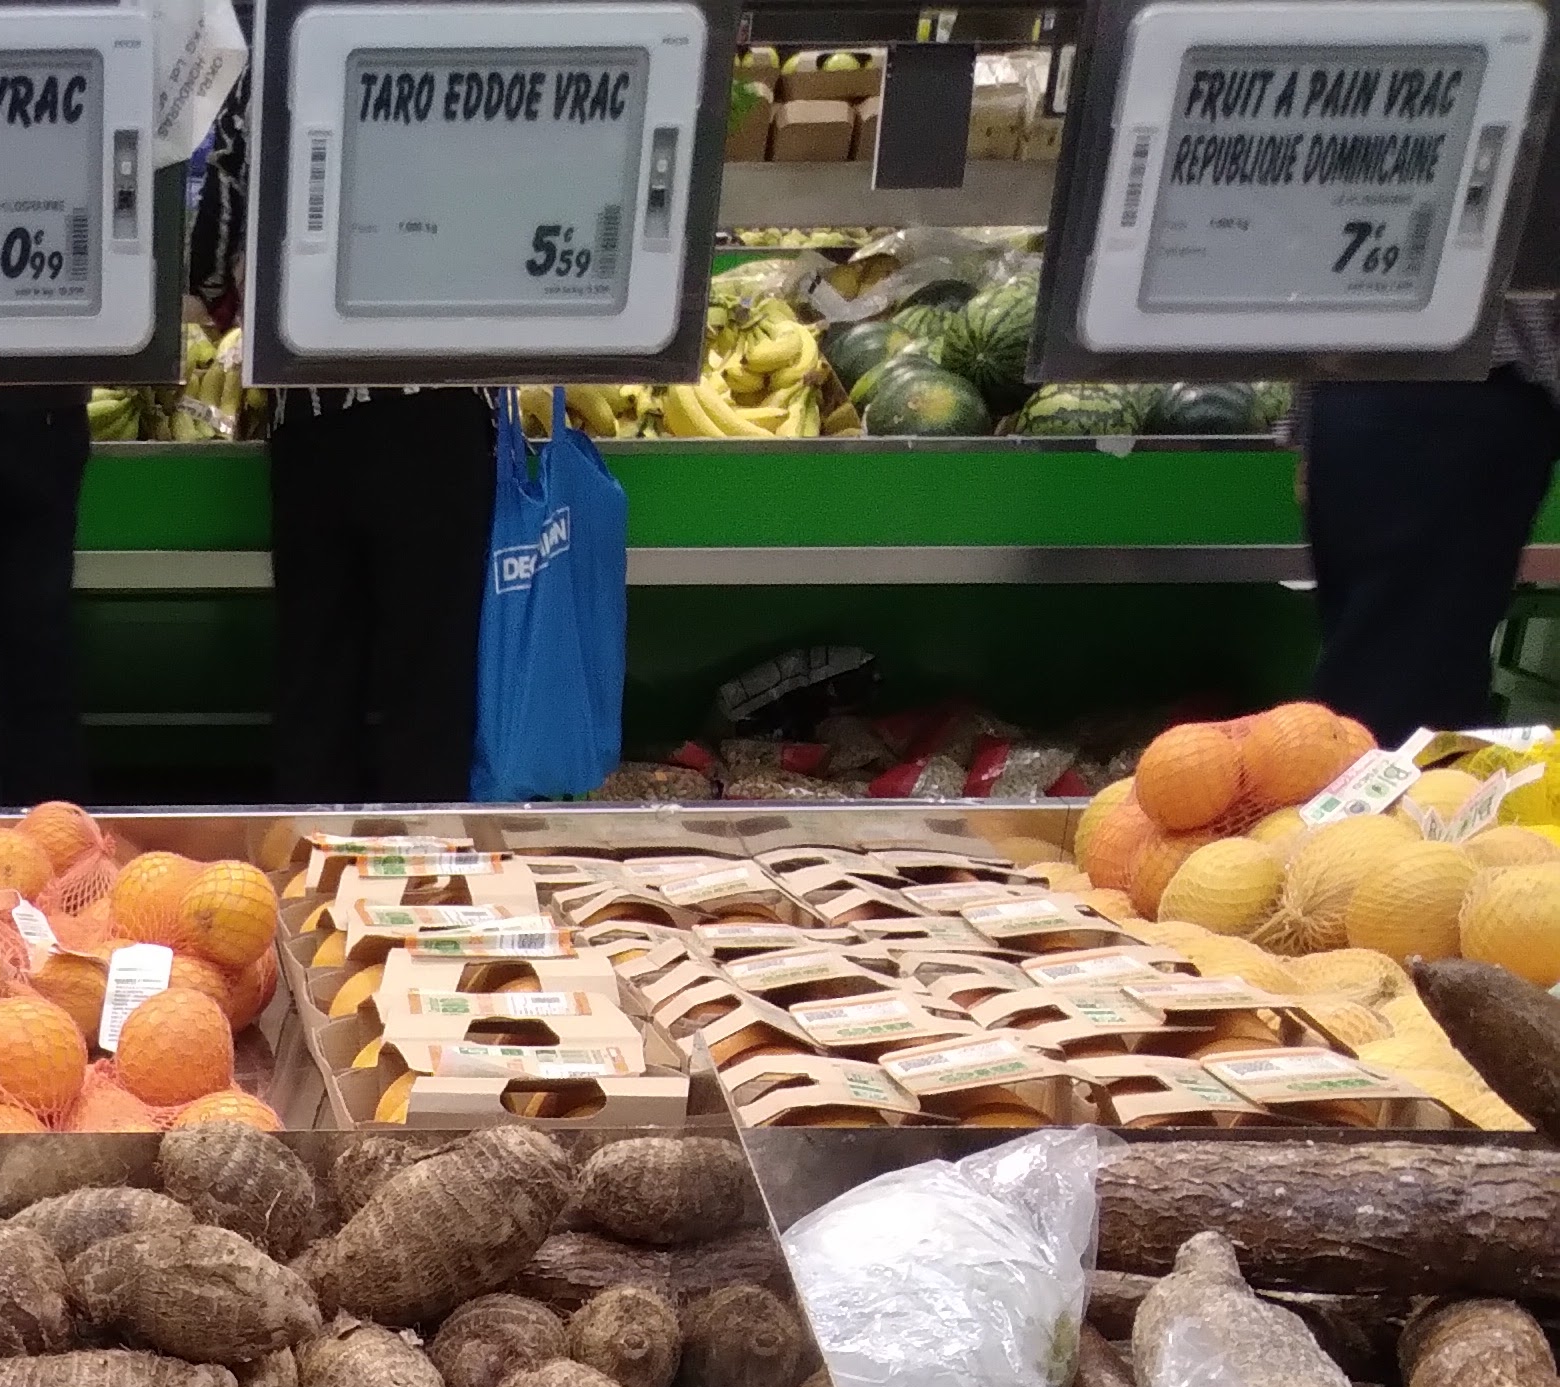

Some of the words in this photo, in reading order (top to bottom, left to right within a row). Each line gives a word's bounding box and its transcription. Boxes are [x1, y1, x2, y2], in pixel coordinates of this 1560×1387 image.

[196, 56, 224, 97] OKRA
[359, 71, 435, 123] TARO
[443, 71, 546, 121] EDDOE
[554, 70, 630, 124] VRAC
[1184, 69, 1276, 122] FRUIT
[1274, 71, 1300, 118] A
[1302, 69, 1382, 119] PAIN
[1383, 69, 1464, 124] VRAC
[1170, 133, 1303, 187] REPUBLIQUE
[1303, 133, 1446, 187] DOMINICAINE
